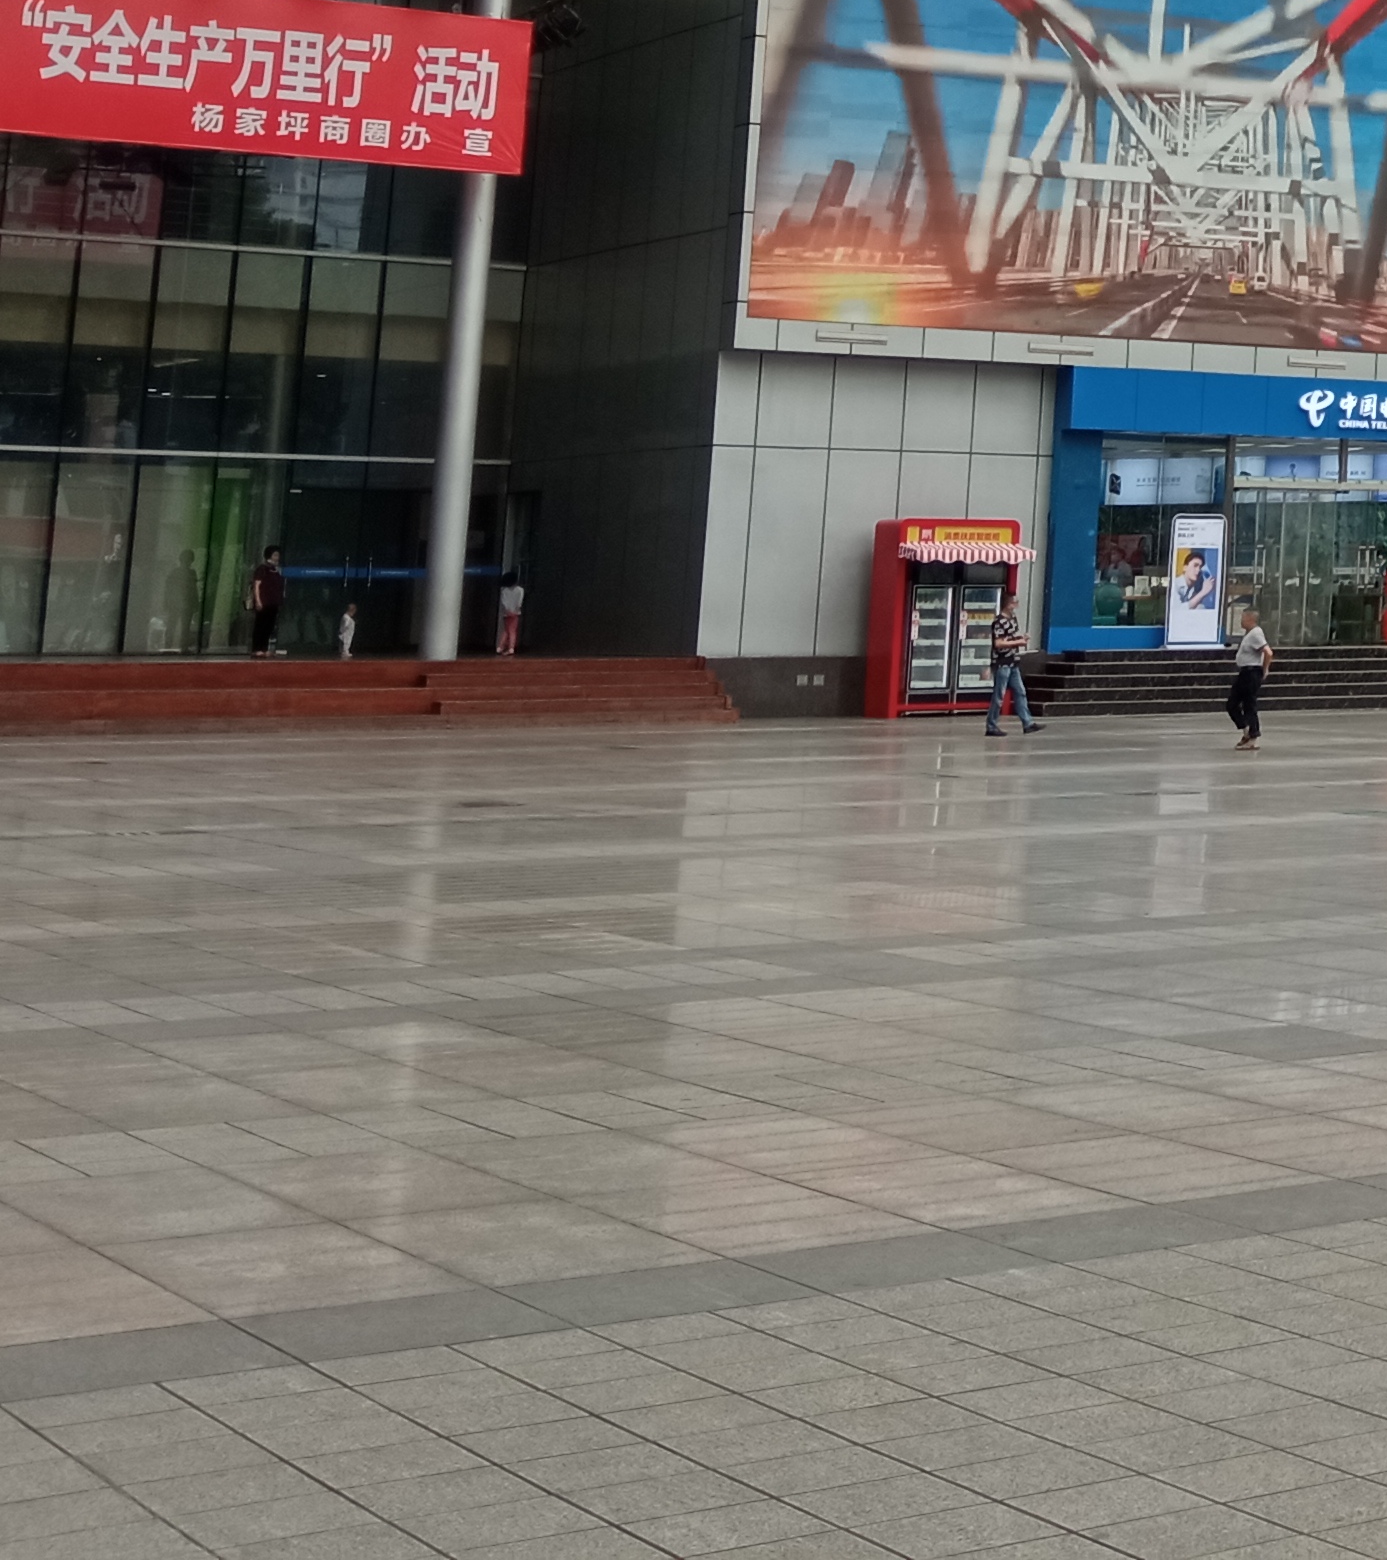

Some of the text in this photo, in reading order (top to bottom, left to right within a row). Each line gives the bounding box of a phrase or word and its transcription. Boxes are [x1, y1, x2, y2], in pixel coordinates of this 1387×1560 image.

[411, 44, 500, 121] 活动
[190, 102, 494, 158] 杨家坪商圈办 宣
[1338, 419, 1370, 429] CHINA
